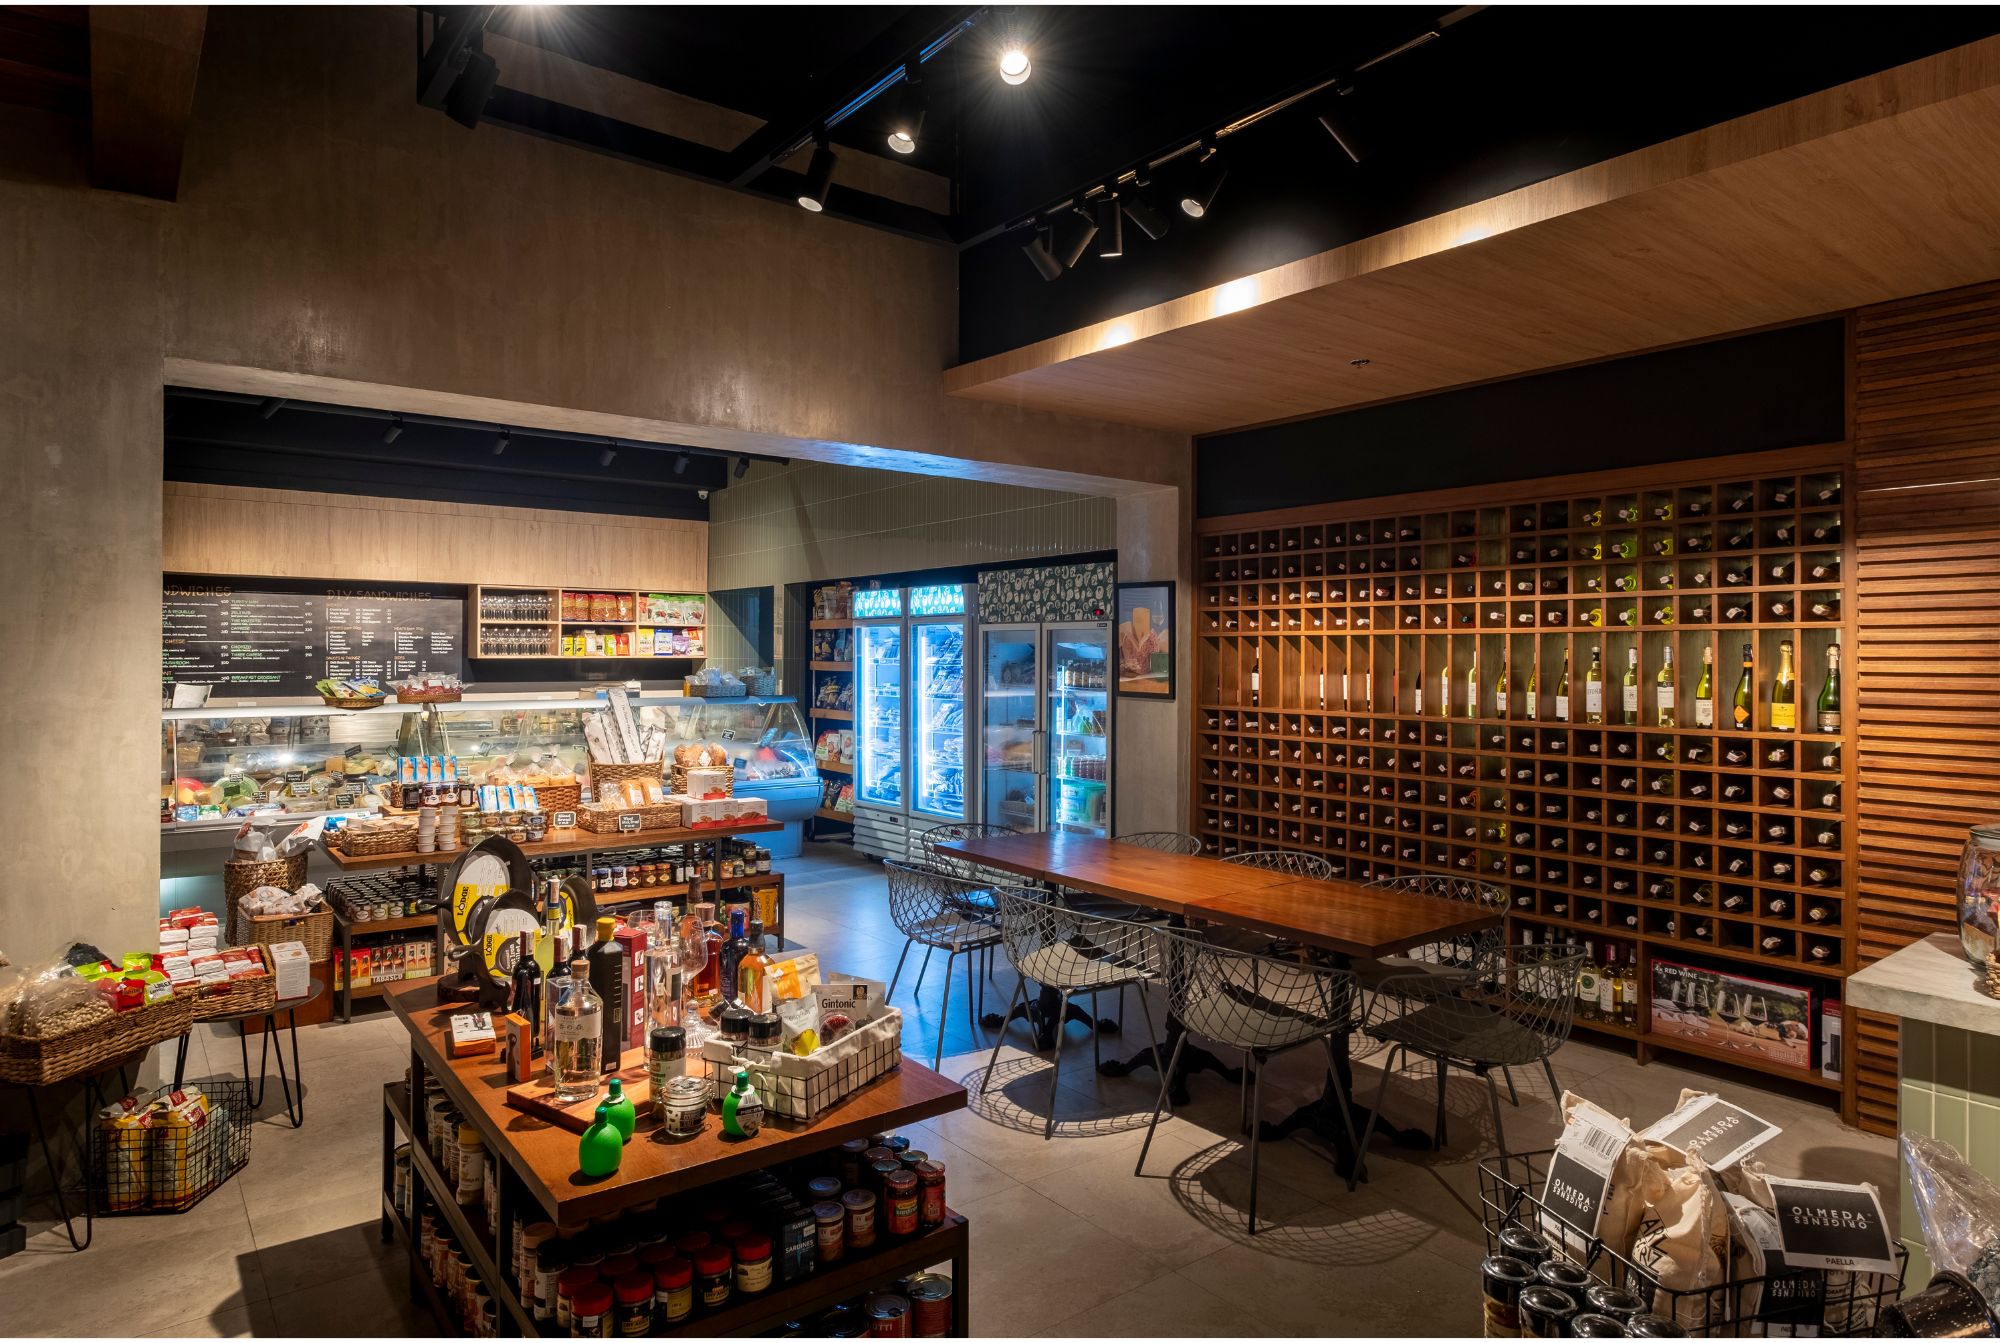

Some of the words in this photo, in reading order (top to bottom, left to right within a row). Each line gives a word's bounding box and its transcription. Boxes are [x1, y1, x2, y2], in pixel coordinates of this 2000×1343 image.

[1664, 967, 1677, 975] RED
[1678, 970, 1698, 979] WINE
[821, 998, 856, 1009] Gintonic
[1689, 1115, 1734, 1146] OLMEDA
[1552, 1185, 1589, 1213] ORIGENES
[1554, 1178, 1591, 1206] OLMEDA
[1791, 1206, 1866, 1220] OLMEDA
[1794, 1215, 1868, 1230] ORIGENES
[785, 1239, 814, 1254] SARDINES
[1825, 1257, 1855, 1266] PAELLA
